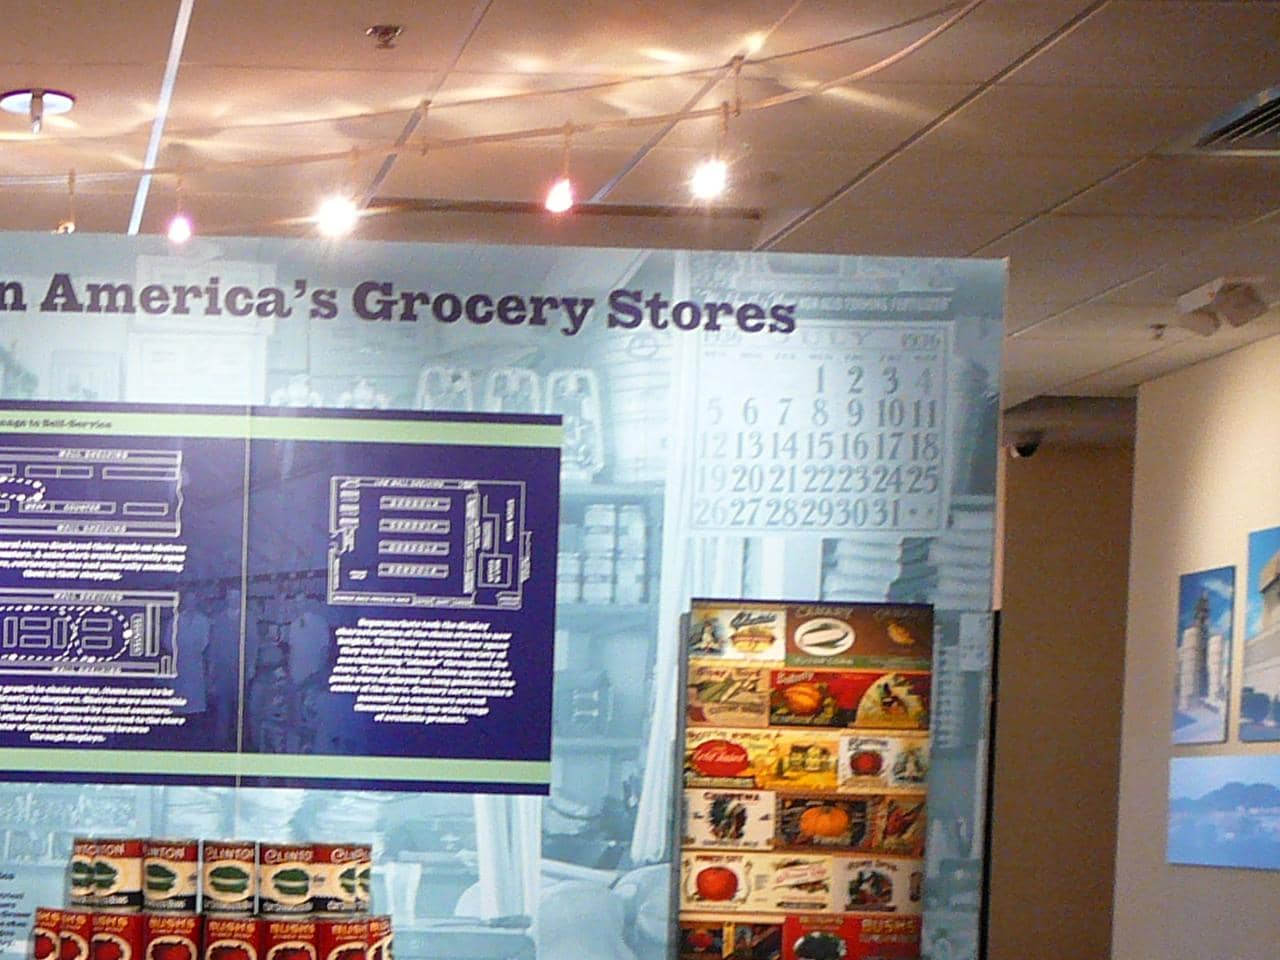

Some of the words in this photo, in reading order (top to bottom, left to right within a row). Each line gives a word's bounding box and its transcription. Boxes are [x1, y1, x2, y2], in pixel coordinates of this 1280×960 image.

[41, 272, 338, 320] America's
[352, 281, 595, 337] Grocery
[607, 288, 797, 334] Stores
[816, 365, 826, 394] 1
[847, 365, 864, 394] 2
[883, 365, 898, 394] 3
[743, 399, 758, 426] 6
[778, 399, 792, 426] 7
[812, 400, 828, 427] 8
[847, 400, 864, 427] 9
[877, 400, 903, 427] 10
[912, 400, 936, 427] 11
[700, 433, 727, 460] 12
[735, 433, 763, 460] 13
[771, 433, 798, 460] 14
[806, 434, 832, 461] 15
[841, 434, 868, 461] 16
[876, 434, 903, 461] 17
[911, 434, 938, 461] 18
[700, 466, 726, 493] 19
[732, 466, 763, 493] 20
[769, 466, 797, 493] 21
[803, 467, 834, 494] 22
[837, 467, 867, 494] 23
[872, 467, 903, 494] 24
[906, 467, 938, 494] 25
[694, 499, 726, 527] 26
[730, 499, 760, 527] 27
[766, 499, 797, 527] 28
[801, 499, 835, 527] 29
[836, 499, 868, 527] 30
[872, 499, 900, 527] 31
